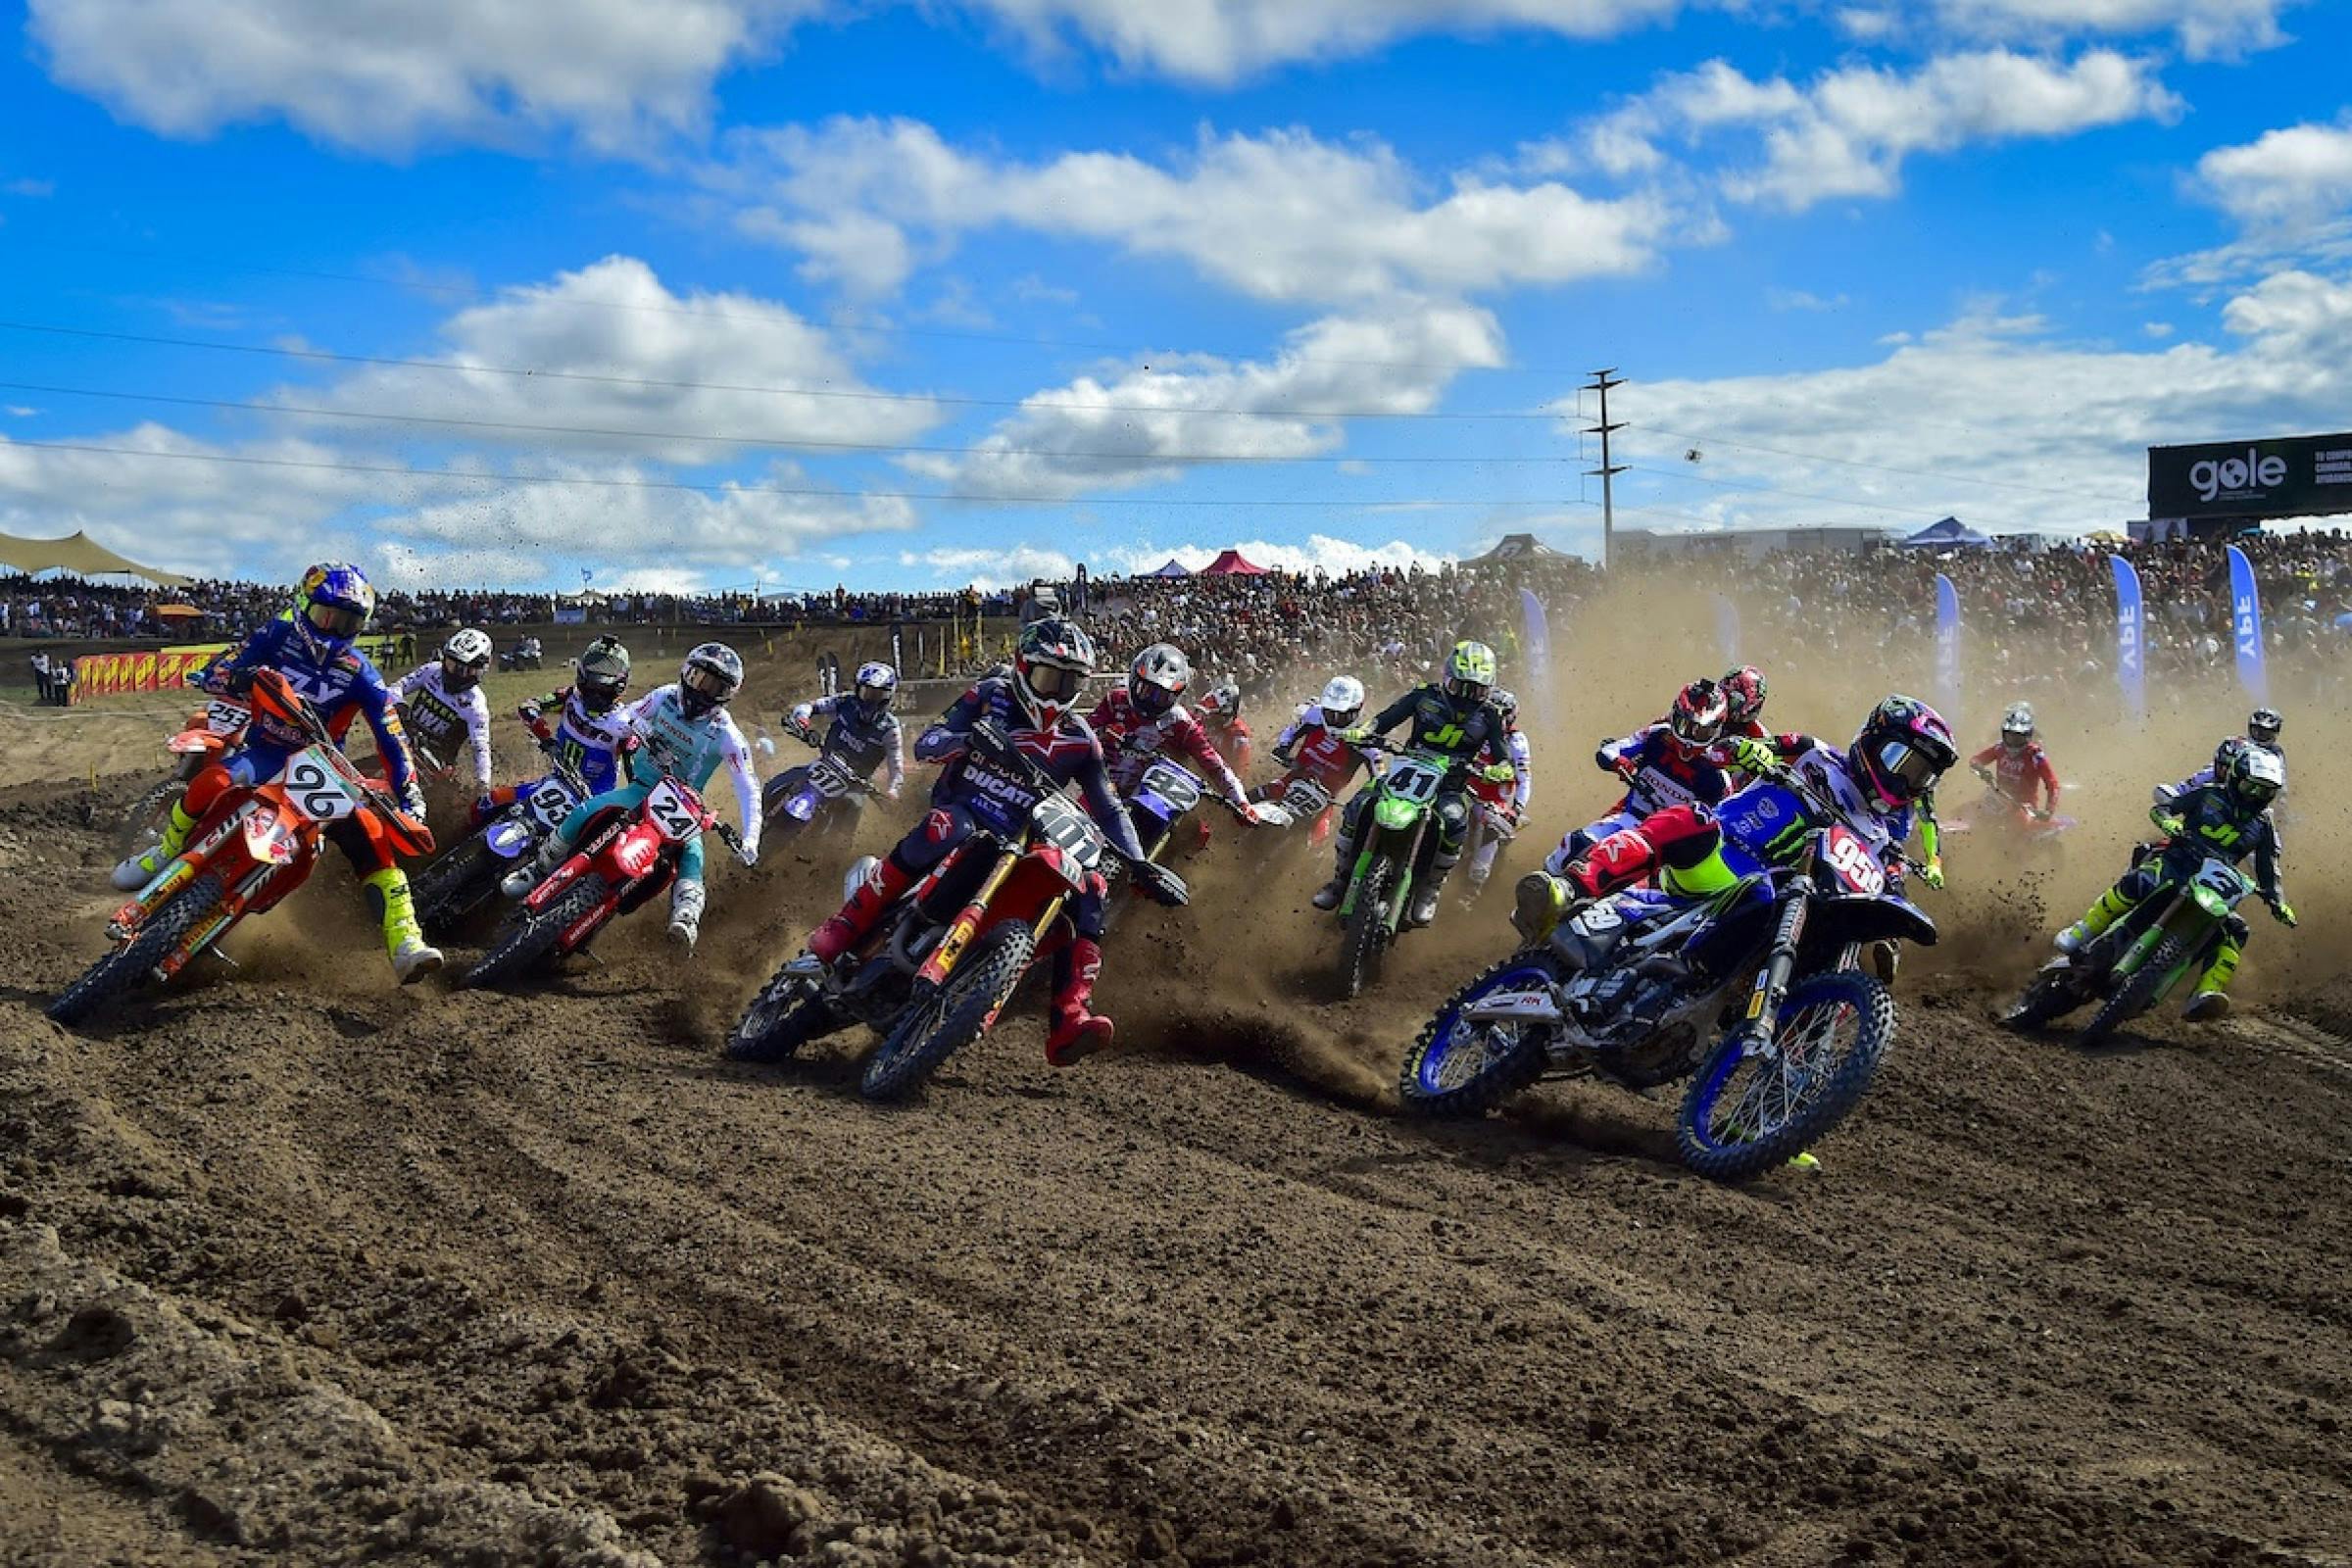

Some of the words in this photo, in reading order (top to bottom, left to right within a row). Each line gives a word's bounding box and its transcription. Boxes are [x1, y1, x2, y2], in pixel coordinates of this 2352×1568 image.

[2188, 447, 2287, 502] gole
[209, 703, 250, 726] 253
[285, 764, 346, 817] 96
[809, 763, 845, 793] 517
[963, 764, 1035, 808] DUCATI
[1388, 767, 1435, 798] 41
[1643, 770, 1690, 803] HONDA
[651, 795, 694, 837] 24
[1833, 837, 1884, 894] 959
[2198, 871, 2242, 900] 3
